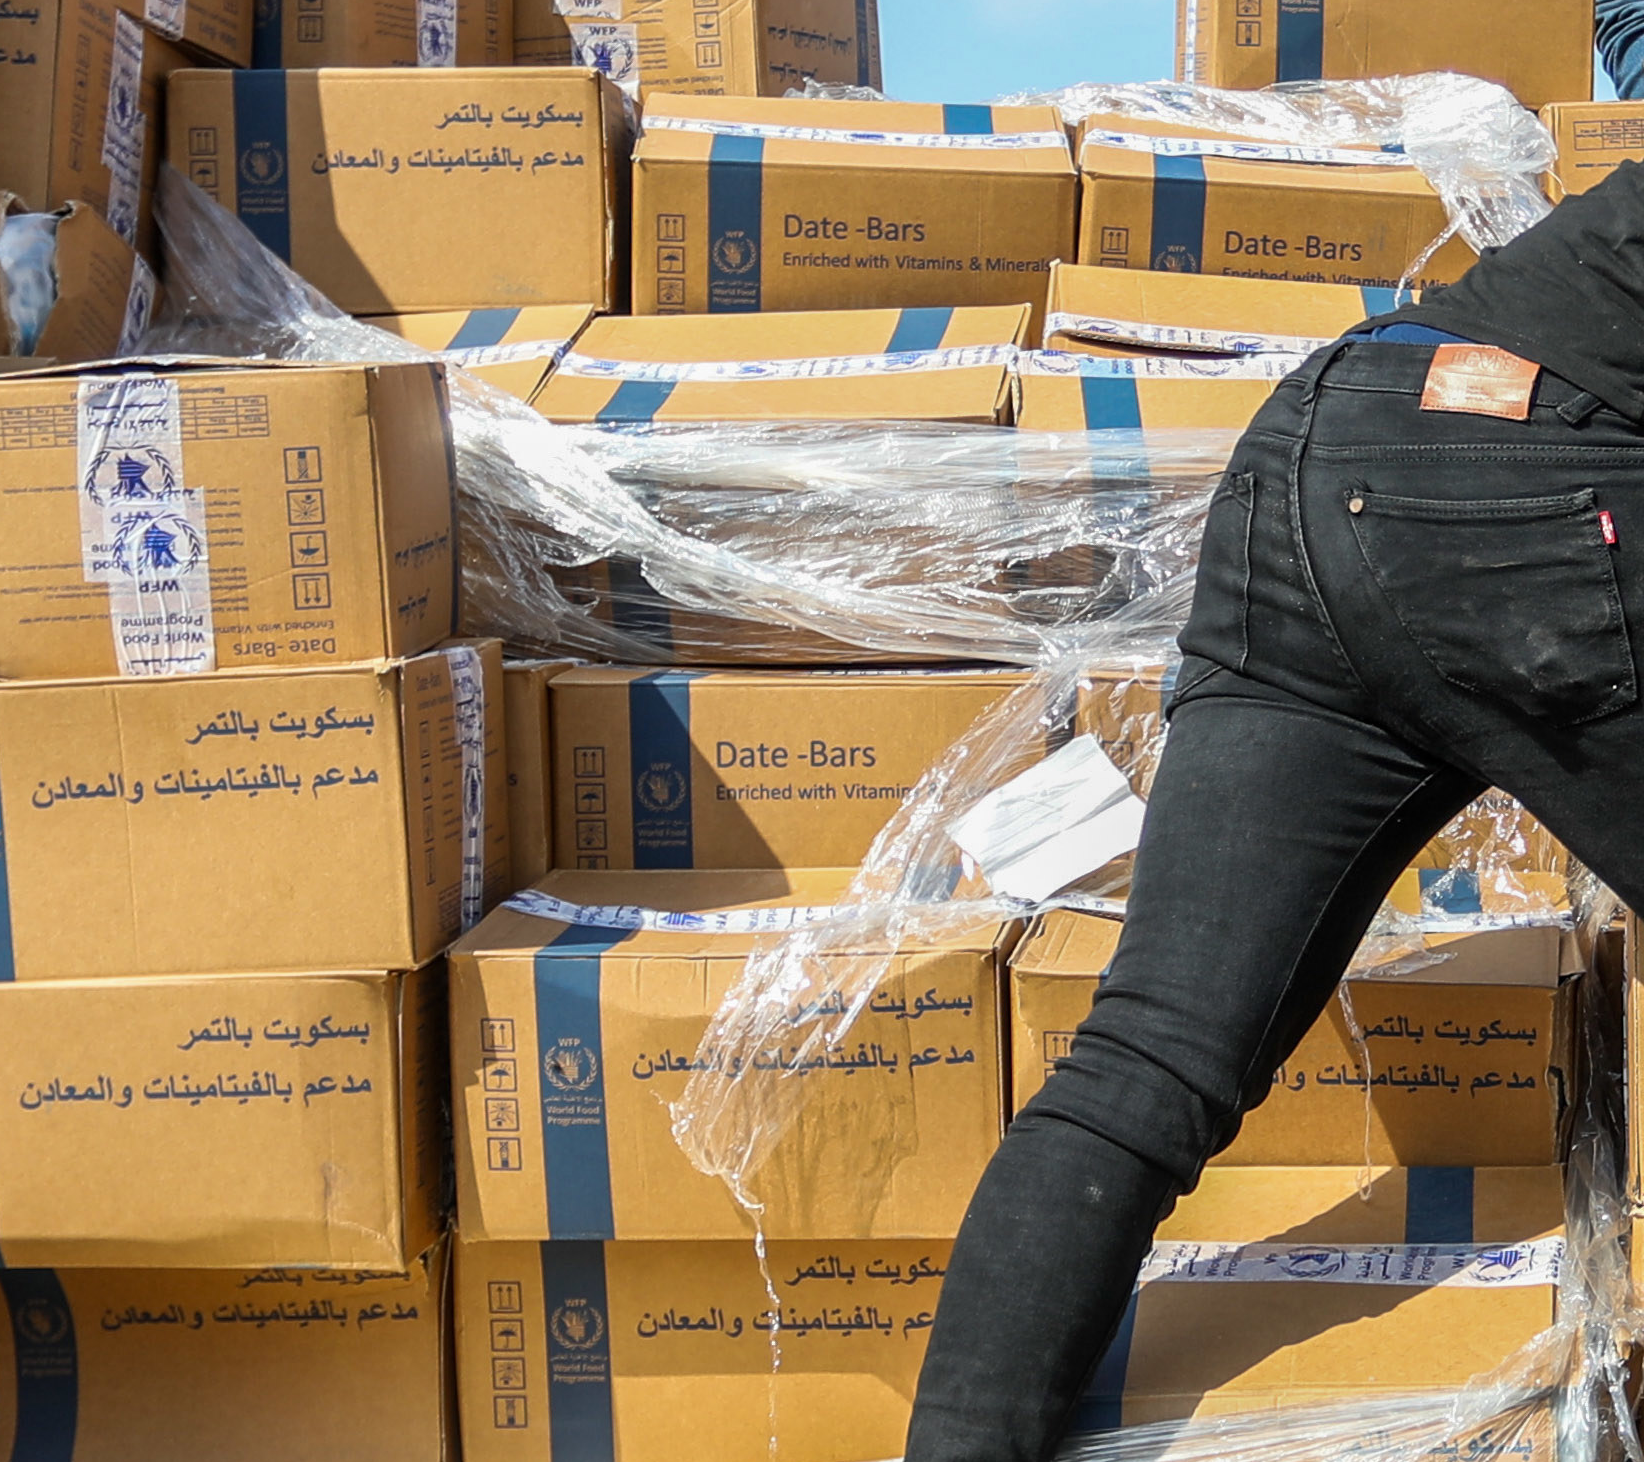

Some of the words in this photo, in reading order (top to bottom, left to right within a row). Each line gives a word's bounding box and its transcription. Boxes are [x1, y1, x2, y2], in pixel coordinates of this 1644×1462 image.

[783, 213, 849, 240] Date
[855, 216, 925, 243] -Bars
[1224, 230, 1288, 258] Date
[1294, 235, 1362, 262] -Bars
[782, 251, 851, 268] Enriched
[854, 253, 890, 269] with
[894, 254, 964, 272] Vitamins
[985, 257, 1052, 274] Minerals
[185, 709, 260, 745] بالتمر
[269, 706, 375, 740] بسكويت
[716, 741, 789, 769] Date
[797, 740, 877, 768] -Bars
[31, 772, 144, 809] والمعادن
[153, 771, 302, 801] بالفيتامينات
[311, 766, 379, 799] مدعم
[716, 782, 793, 801] Enriched
[797, 782, 837, 800] with
[869, 988, 973, 1021] بسكويت
[177, 1016, 253, 1051] بالتمر
[263, 1015, 370, 1048] بسكويت
[1434, 1019, 1537, 1047] بسكويت
[907, 1045, 975, 1079] مدعم
[19, 1075, 133, 1110] والمعادن
[143, 1070, 293, 1107] بالفيتامينات
[303, 1074, 372, 1108] مدعم
[1469, 1071, 1536, 1098] مدعم
[784, 1255, 856, 1287] بالتمر
[100, 1304, 204, 1332] والمعادن
[212, 1299, 348, 1329] بالفيتامينات
[357, 1302, 419, 1330] مدعم
[636, 1307, 743, 1338] والمعادن
